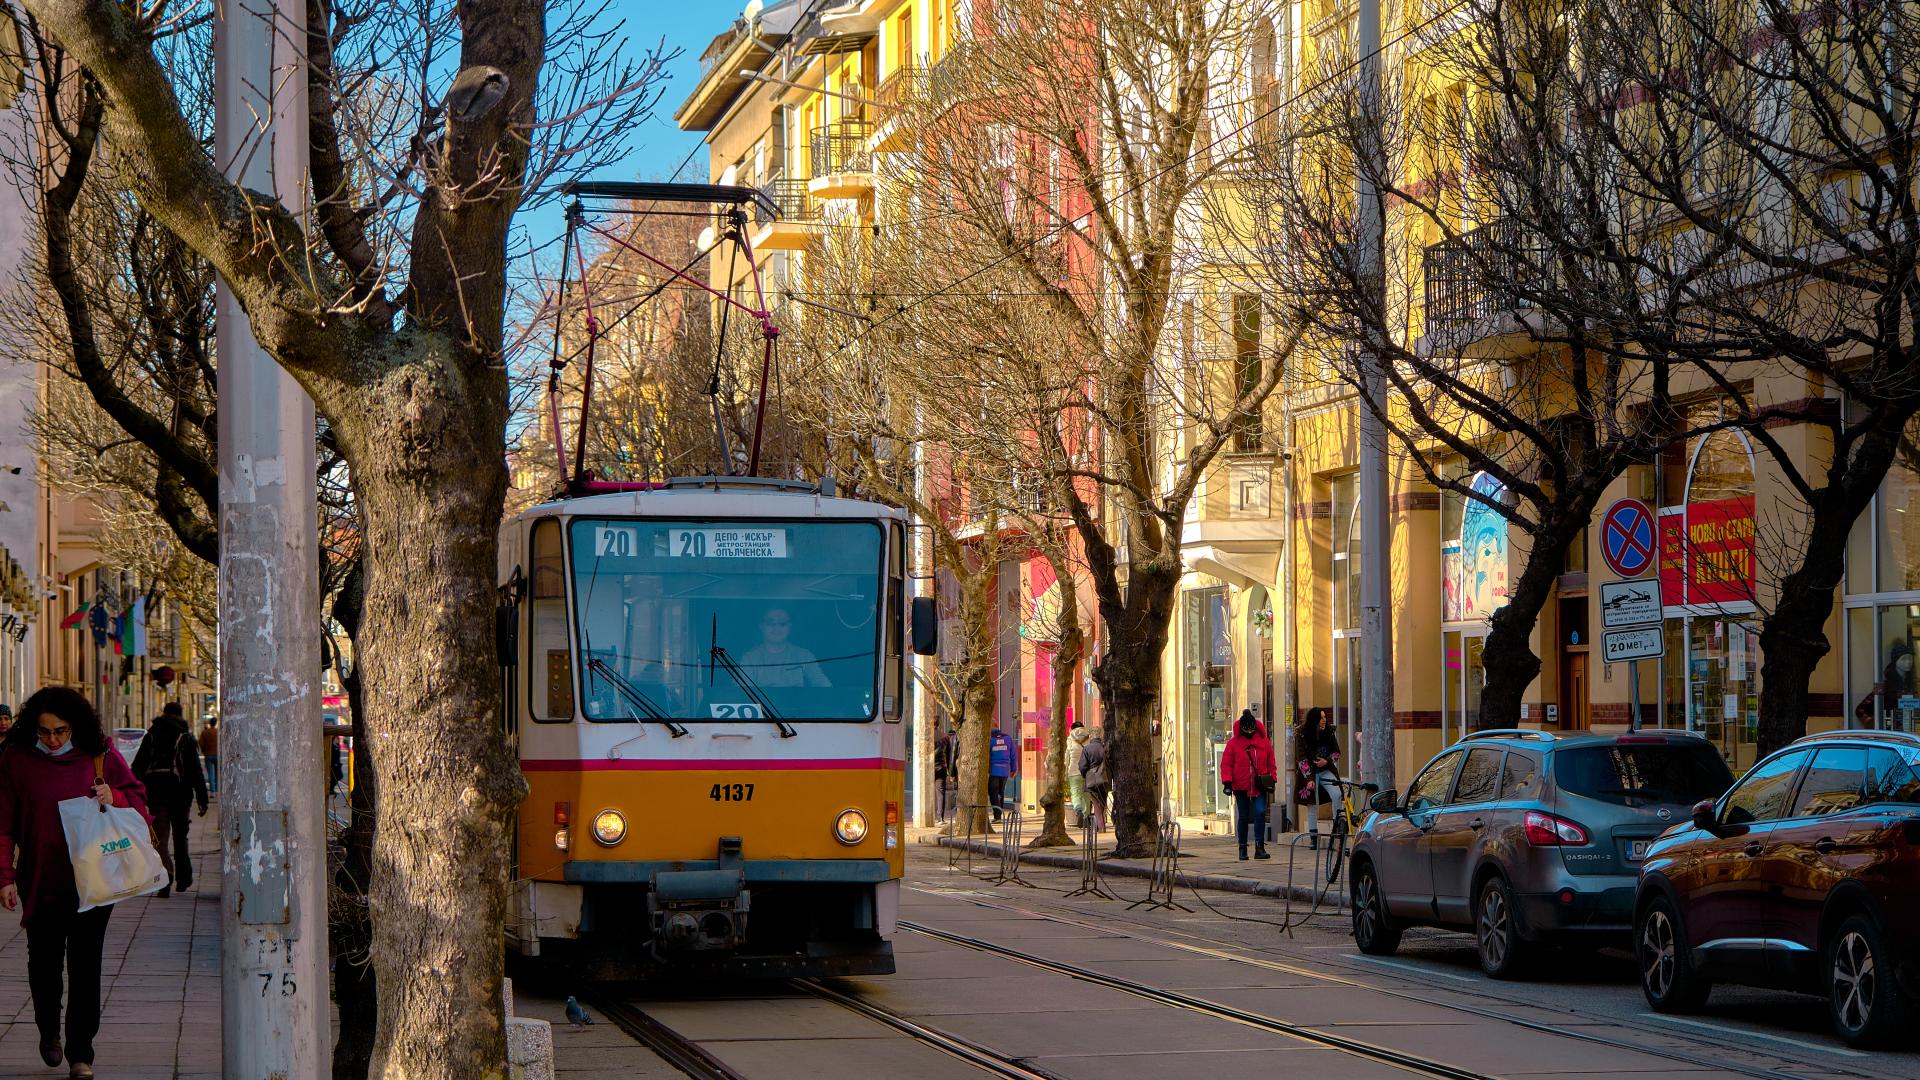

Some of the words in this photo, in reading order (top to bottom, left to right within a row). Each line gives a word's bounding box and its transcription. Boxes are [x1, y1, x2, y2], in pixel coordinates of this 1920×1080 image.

[603, 530, 630, 556] 20
[679, 531, 706, 556] 20
[714, 532, 738, 542] ДЕПО
[716, 704, 759, 719] 20
[709, 783, 755, 802] 4137
[257, 972, 297, 997] 75
